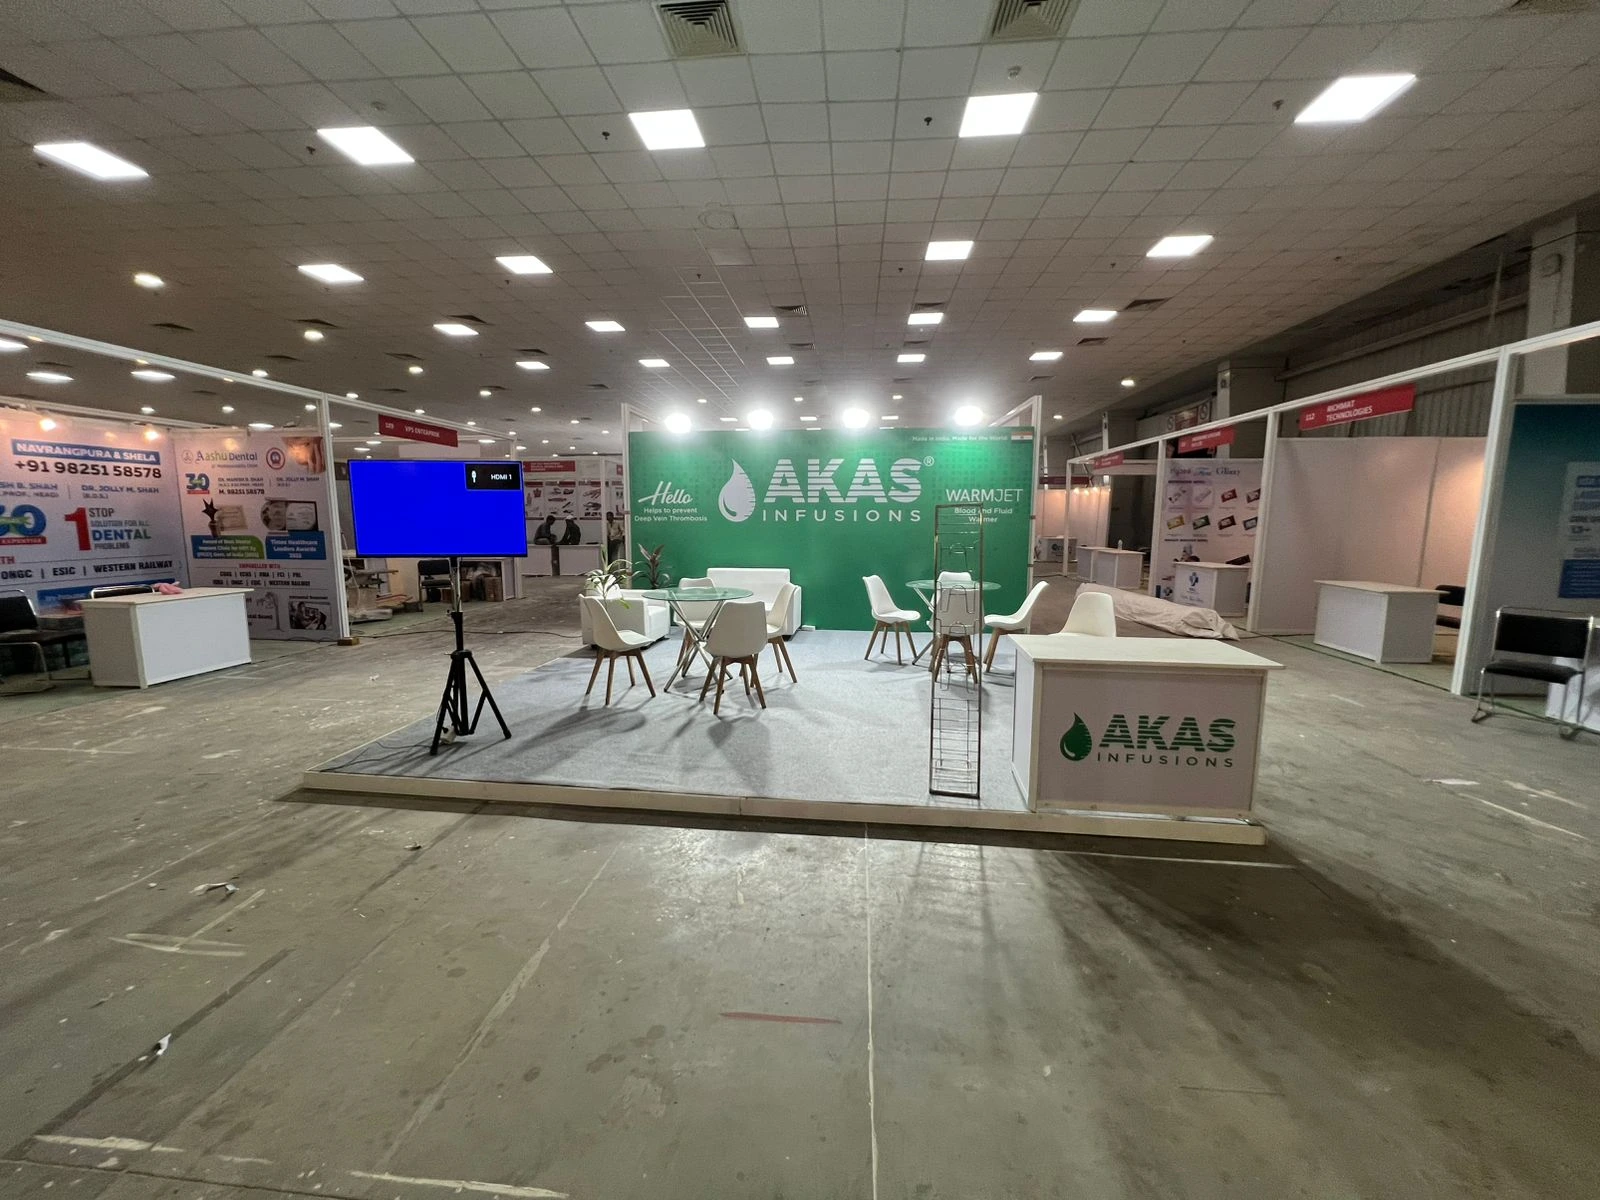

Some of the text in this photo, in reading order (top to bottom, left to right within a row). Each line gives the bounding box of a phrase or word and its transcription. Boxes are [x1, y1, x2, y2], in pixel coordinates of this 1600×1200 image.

[1326, 405, 1373, 422] TECHNOLOGIES
[16, 443, 112, 459] NAVRANGPURA
[122, 452, 156, 461] SHELA
[228, 452, 258, 460] Dental
[15, 460, 162, 479] +91 98251 58578
[763, 457, 923, 504] AKAS
[638, 481, 693, 505] Hello
[945, 488, 1023, 502] WARMJET
[88, 508, 114, 517] STOP
[762, 509, 921, 522] INFUSIONS
[64, 507, 91, 551] 1
[92, 529, 152, 541] DENTAL
[1, 560, 173, 580] ONGC ESIC WESTERN RAILWAY
[1099, 714, 1236, 753] AKAS
[1097, 753, 1233, 768] INFUSIONS
